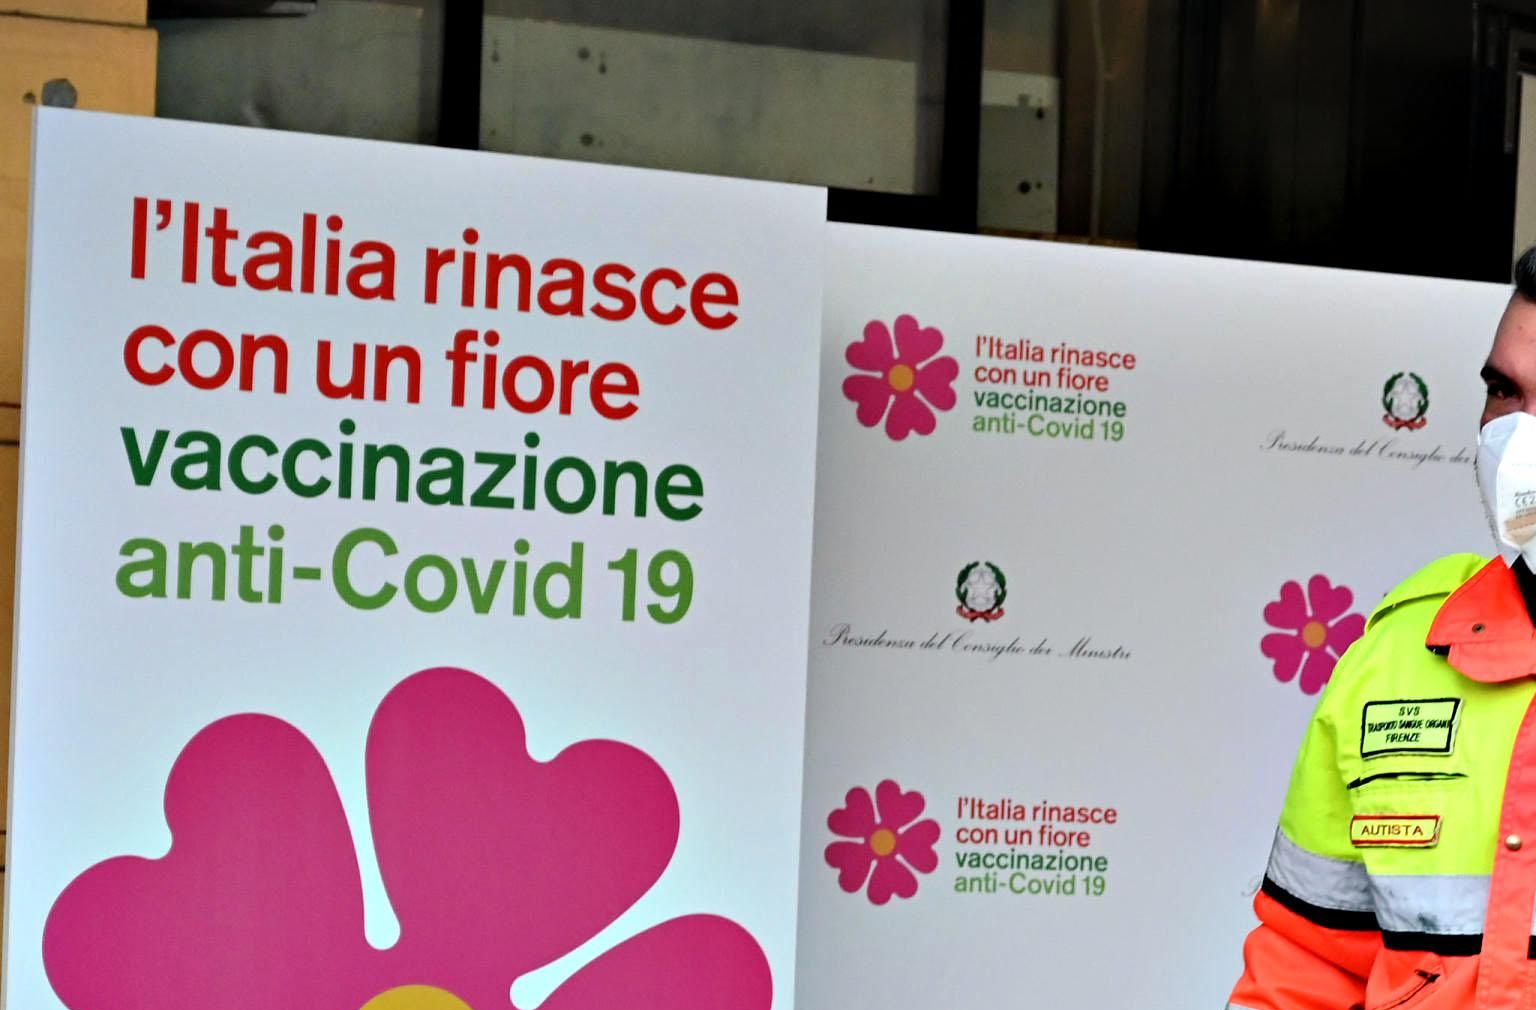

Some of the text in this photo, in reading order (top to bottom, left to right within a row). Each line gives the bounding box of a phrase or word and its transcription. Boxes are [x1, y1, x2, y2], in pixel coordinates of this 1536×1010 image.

[129, 197, 739, 331] l'Italia rinasce
[975, 335, 1136, 370] l'Italia rinasce
[123, 324, 640, 420] con un fiore
[974, 365, 1109, 392] con un fiore
[973, 389, 1127, 418] vaccinazione
[972, 413, 1125, 442] anti-Covid 19
[119, 419, 704, 521] vaccinazione
[115, 526, 694, 624] anti-Covid 19
[1399, 706, 1420, 716] SVS
[1386, 733, 1420, 743] FIRENZE
[957, 797, 1117, 825] l'Italia rinasce
[956, 825, 1091, 848] con un fiore
[1360, 823, 1423, 836] AUTISTA
[955, 849, 1109, 872] vaccinazione
[954, 872, 1106, 896] anti-Covid 19
